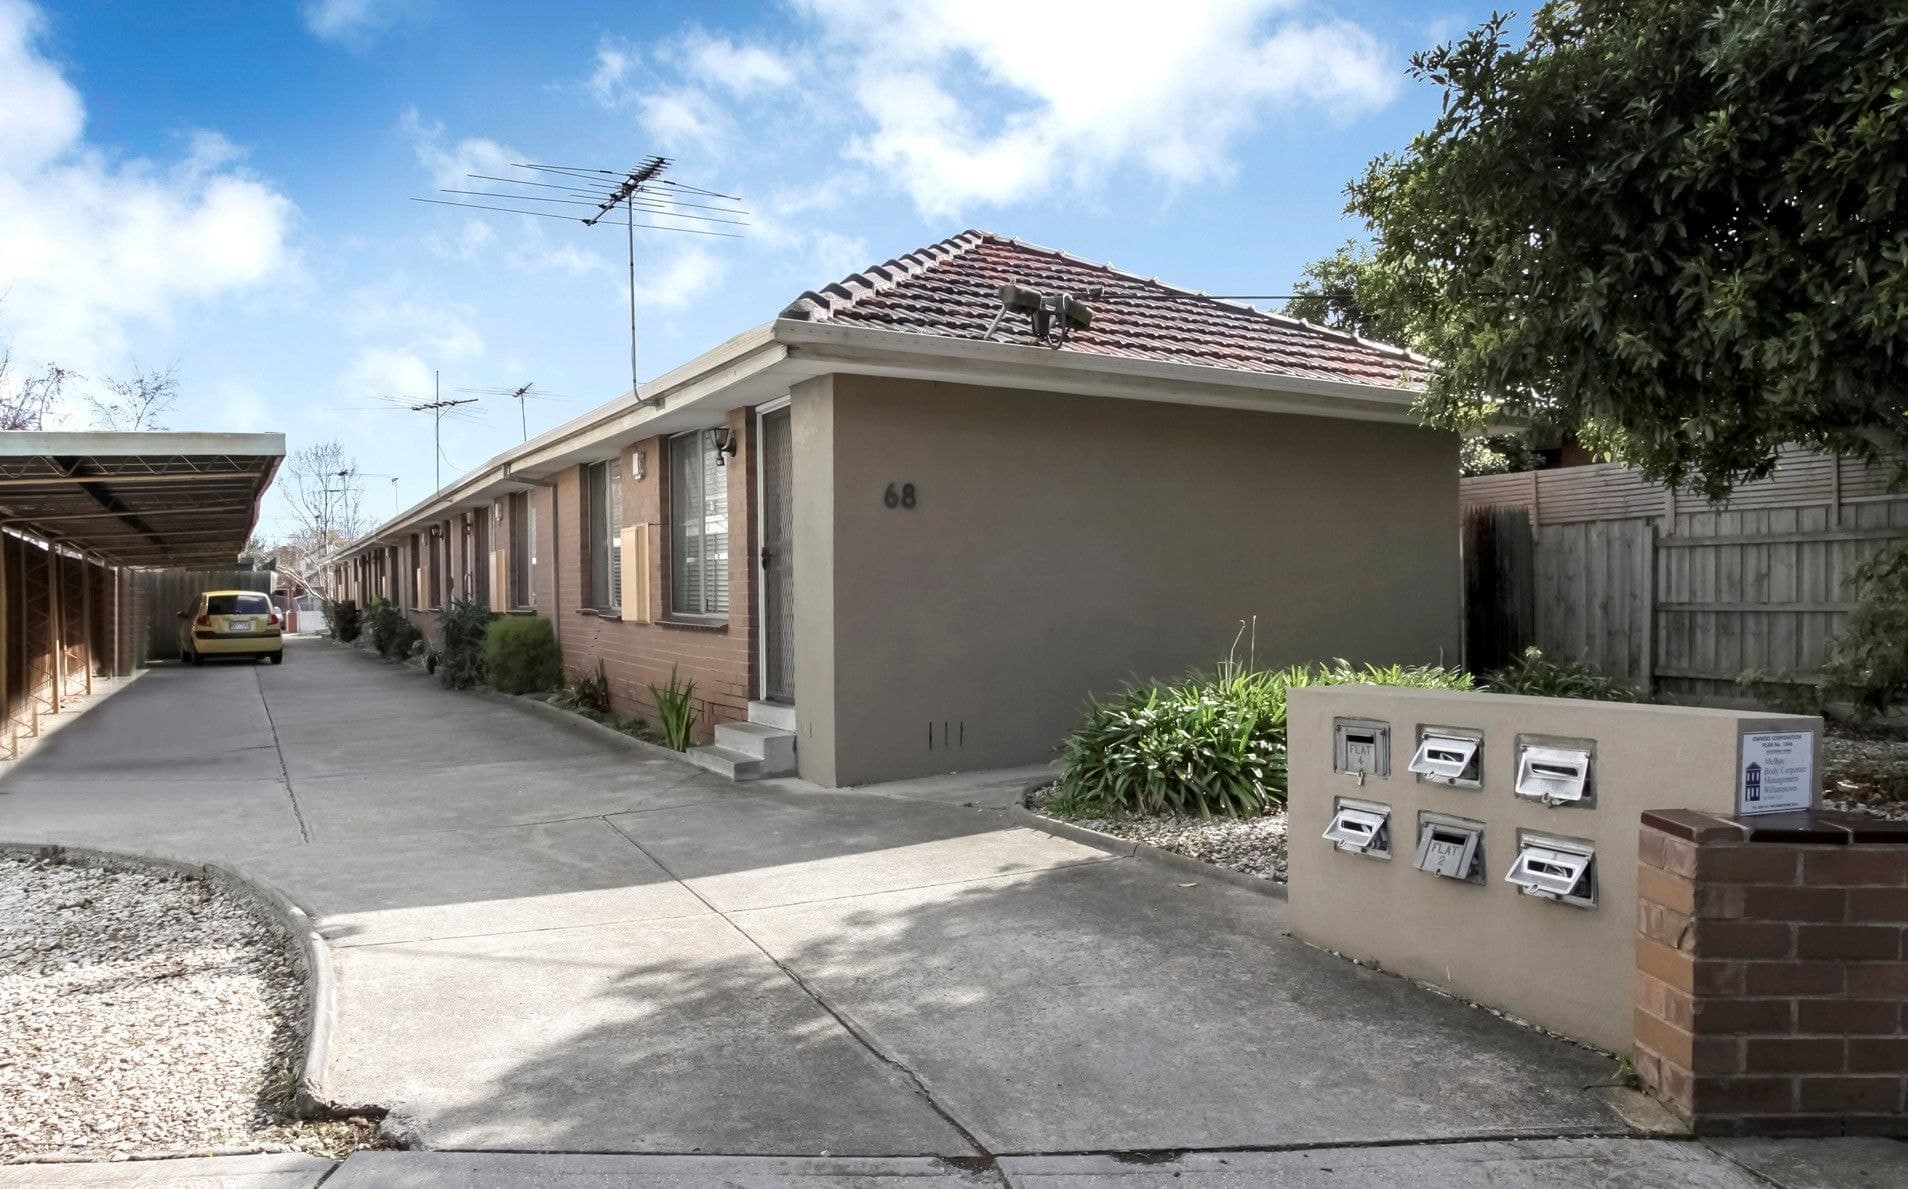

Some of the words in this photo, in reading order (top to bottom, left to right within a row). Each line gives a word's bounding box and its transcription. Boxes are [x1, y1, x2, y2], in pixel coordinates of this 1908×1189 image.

[884, 482, 916, 509] 68
[1350, 745, 1372, 757] FLAT
[1764, 767, 1779, 776] Body
[1780, 766, 1807, 775] Corporate
[1764, 775, 1799, 784] Management
[1432, 842, 1459, 856] FLAT
[1437, 856, 1445, 866] 2
